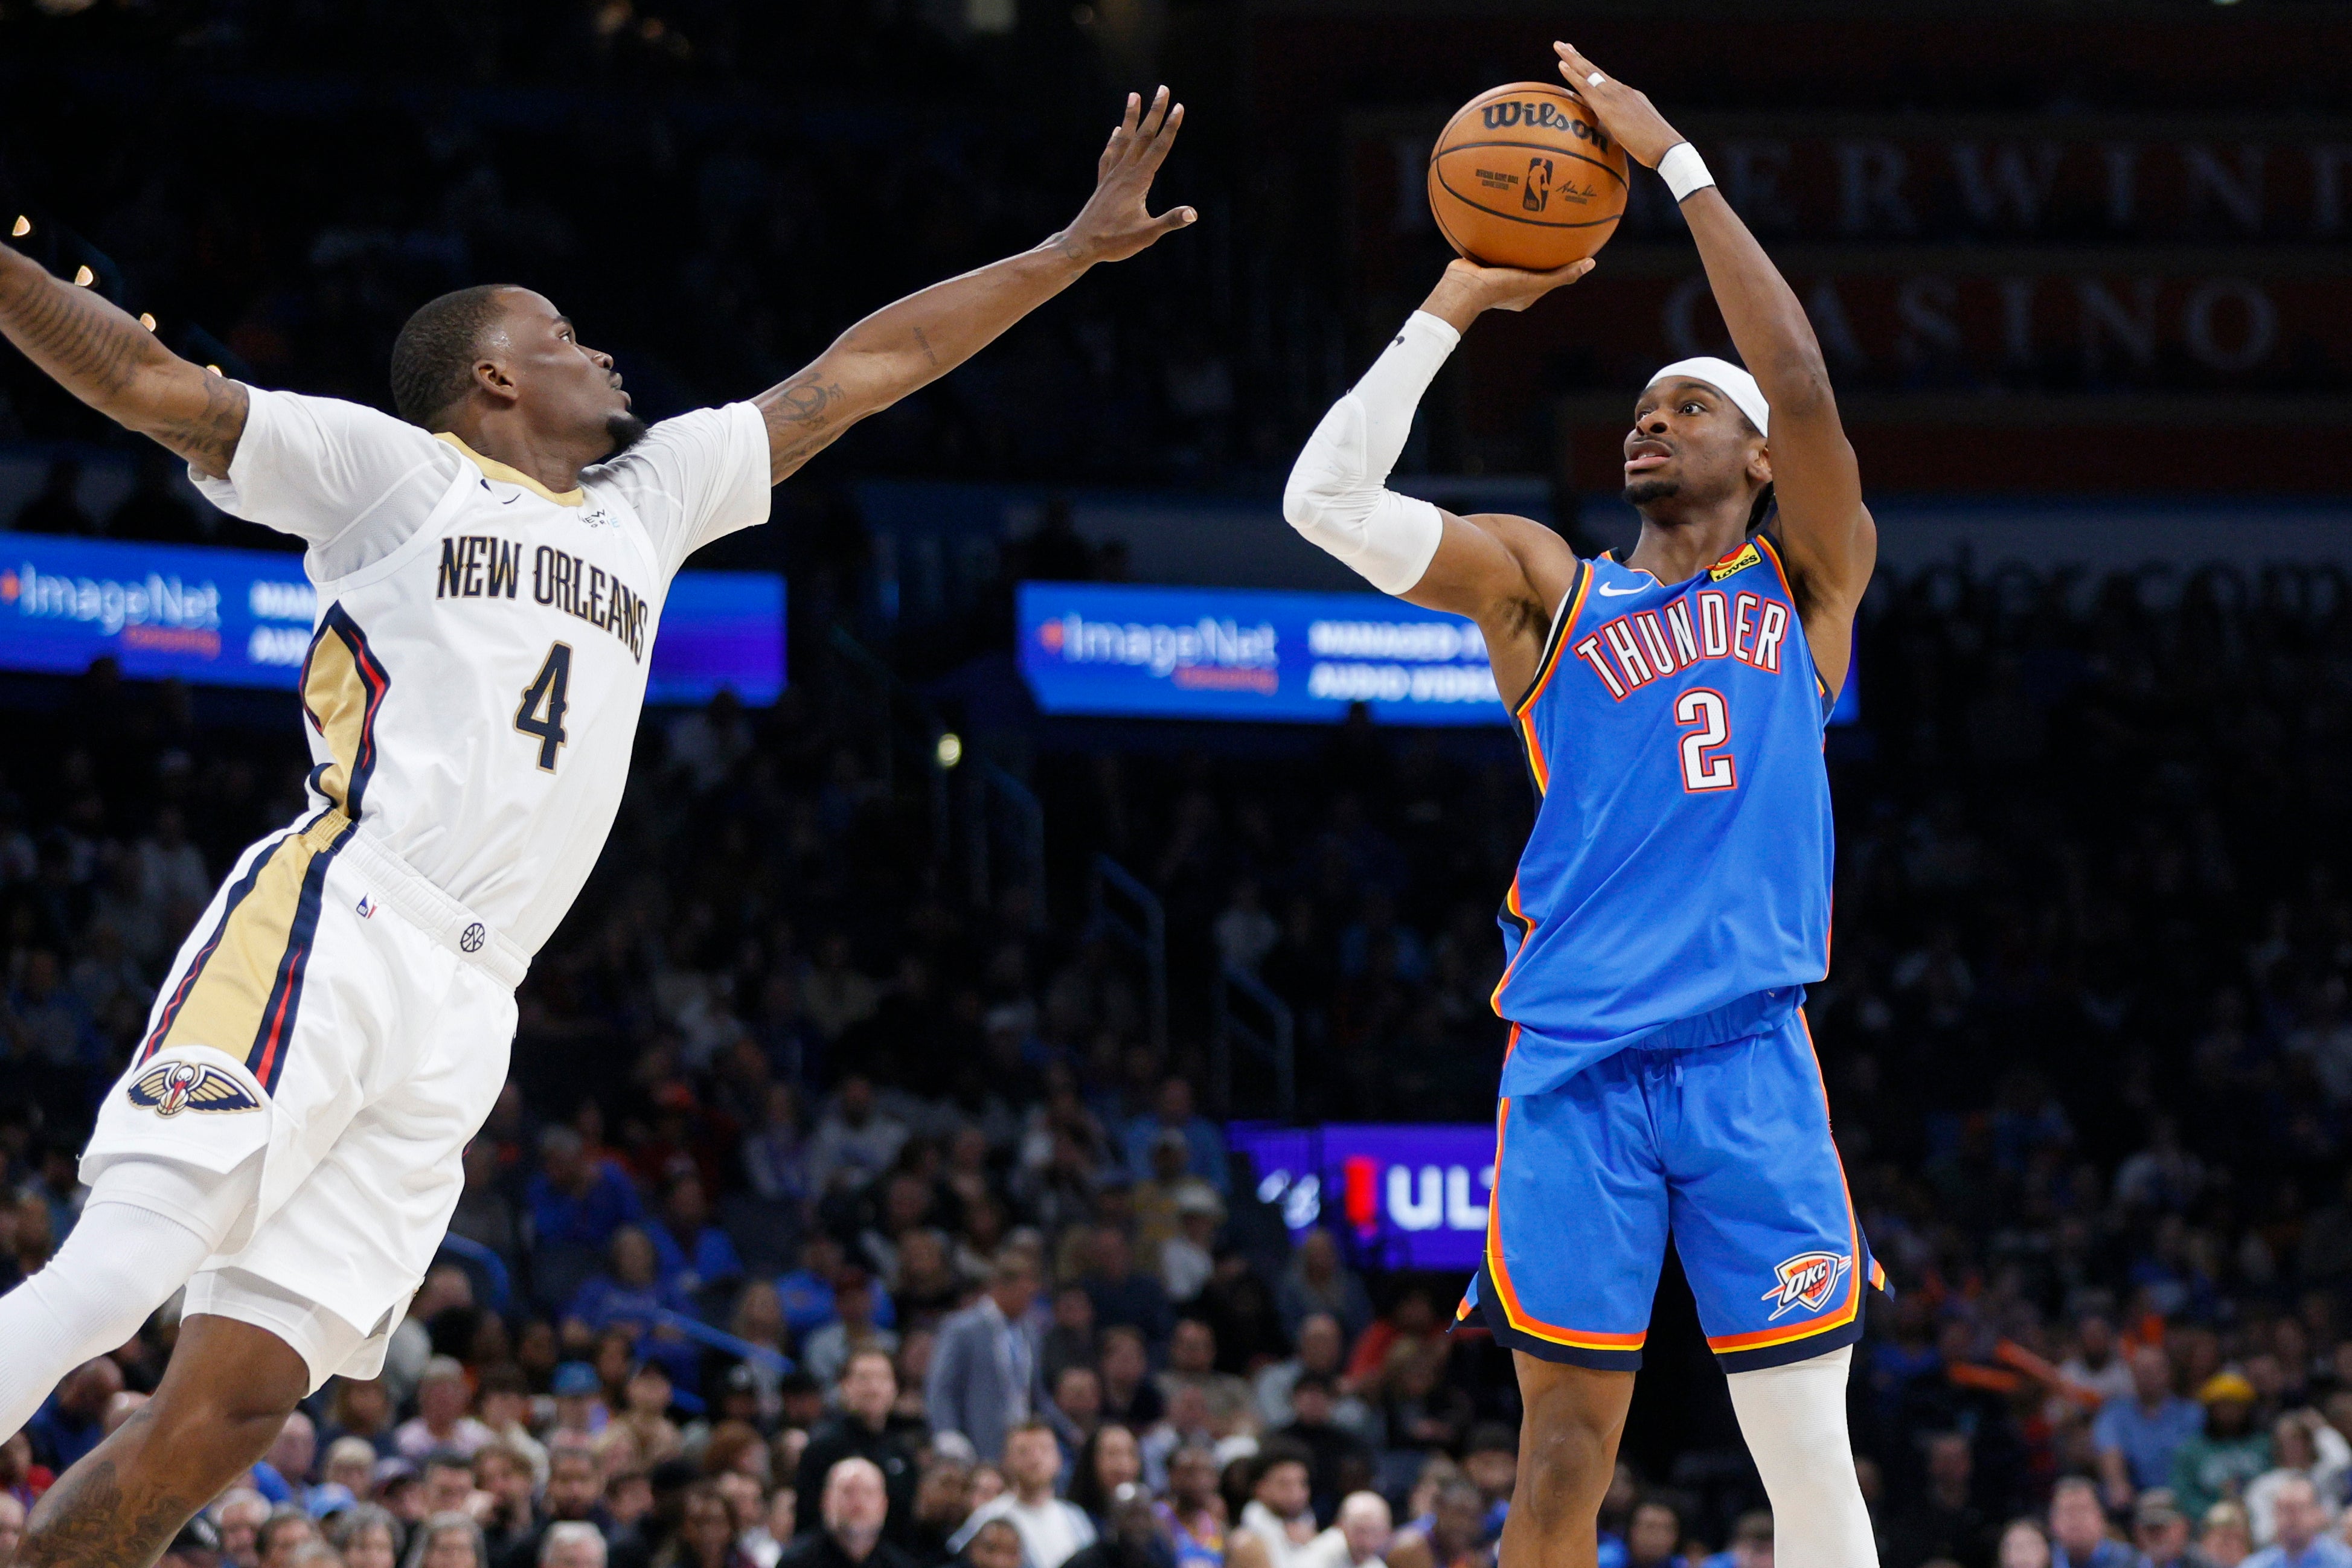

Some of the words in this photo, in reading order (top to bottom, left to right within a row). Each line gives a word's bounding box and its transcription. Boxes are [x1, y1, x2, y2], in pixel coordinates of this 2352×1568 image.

[1481, 100, 1609, 155] Wilson
[20, 562, 221, 636] ImageNet
[436, 536, 522, 600] NEW
[533, 545, 648, 665] ORLEANS
[1063, 612, 1280, 677] ImageNet
[1572, 590, 1790, 703] THUNDER
[513, 640, 573, 775] 4
[1674, 687, 1738, 793] 2
[1782, 1261, 1827, 1304] OKC
